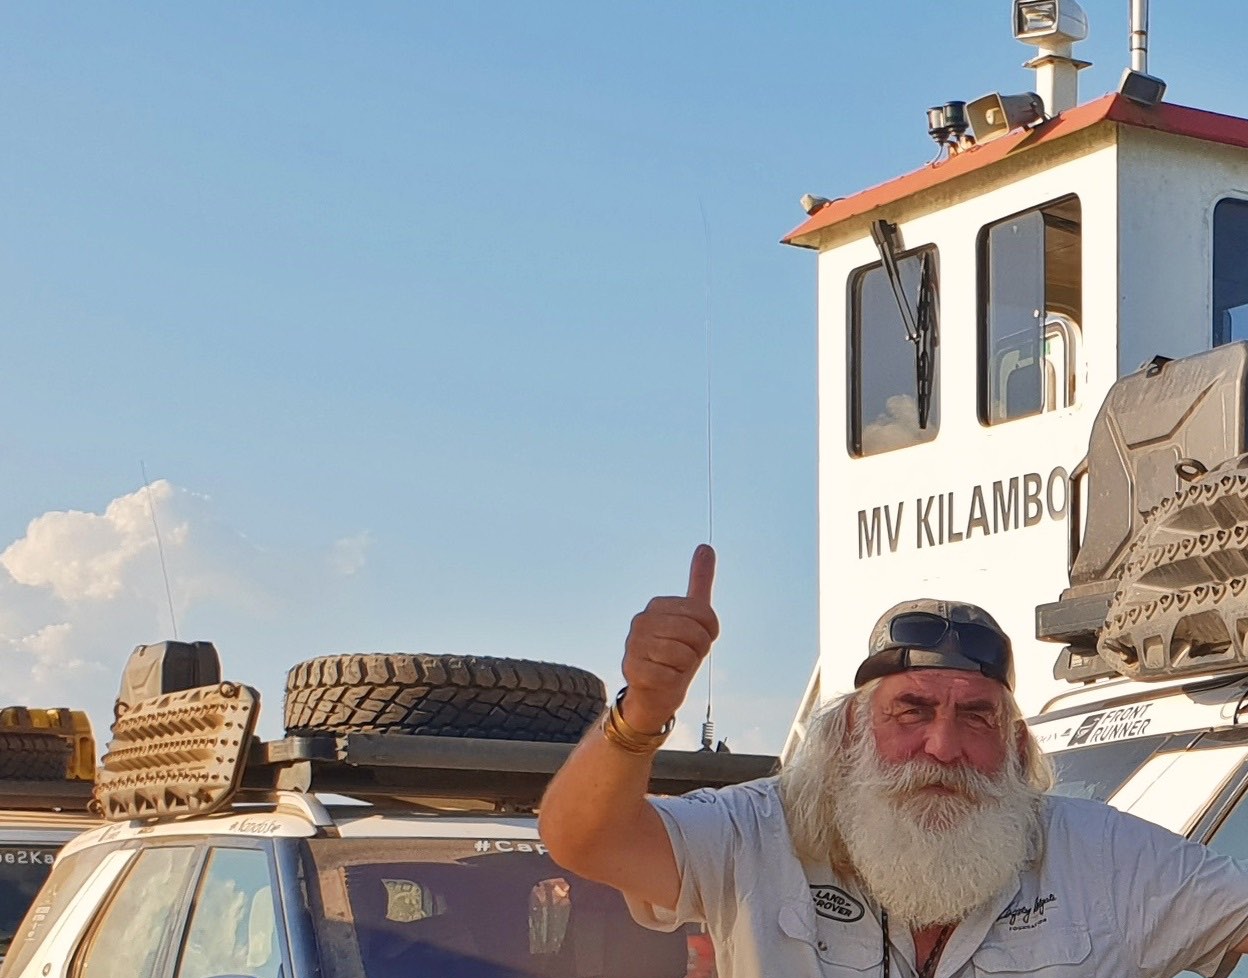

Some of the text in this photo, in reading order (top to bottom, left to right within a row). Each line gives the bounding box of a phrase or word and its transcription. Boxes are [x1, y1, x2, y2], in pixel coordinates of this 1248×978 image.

[858, 466, 1069, 559] MV KILAMBO
[1101, 703, 1154, 725] FRONT
[1090, 719, 1152, 743] RUNNER
